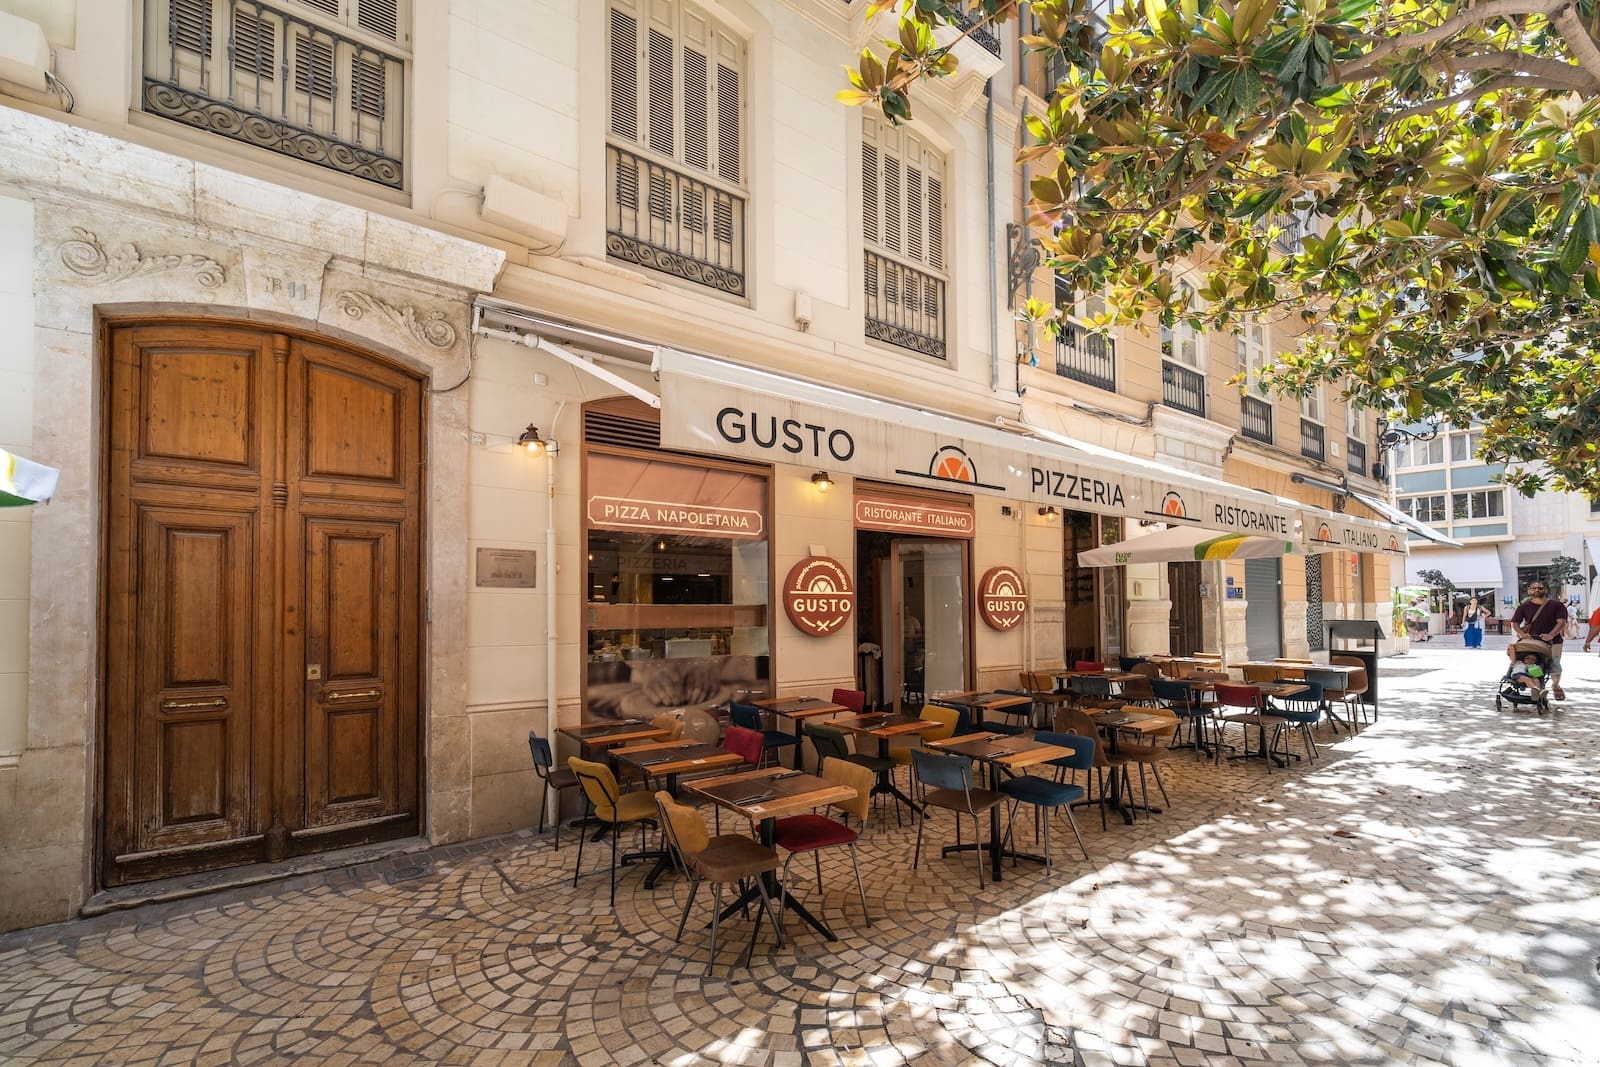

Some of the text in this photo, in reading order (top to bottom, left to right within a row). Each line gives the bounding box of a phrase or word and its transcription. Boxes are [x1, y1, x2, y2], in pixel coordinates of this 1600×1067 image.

[716, 407, 855, 462] GUSTO
[1031, 467, 1126, 508] PIZZERIA
[604, 504, 750, 529] PIZZA NAPOLETANA
[864, 506, 967, 527] RISTORANTE ITALIANO
[1214, 503, 1288, 534] RISTORANTE
[1343, 528, 1378, 548] ITALIANO
[793, 598, 851, 613] GUSTO
[987, 600, 1025, 612] GUSTO
